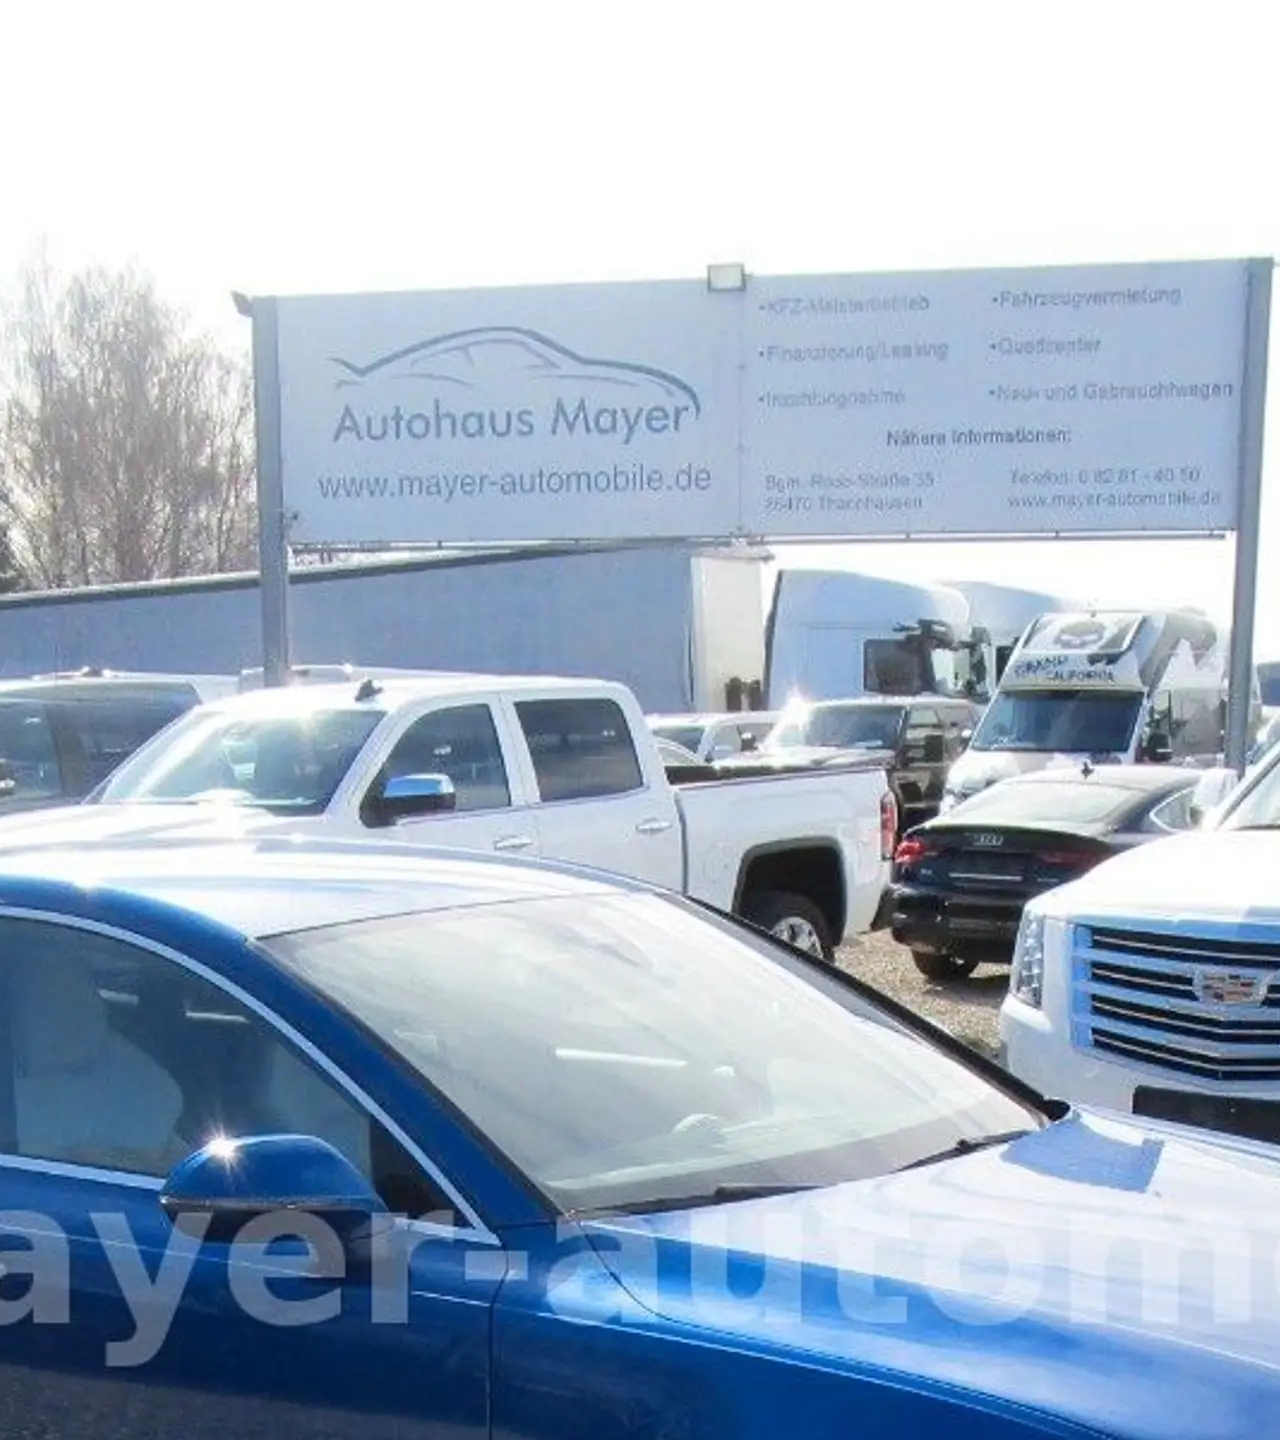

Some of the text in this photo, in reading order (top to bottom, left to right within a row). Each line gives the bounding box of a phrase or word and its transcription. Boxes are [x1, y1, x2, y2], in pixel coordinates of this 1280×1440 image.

[1045, 383, 1077, 400] und
[333, 396, 687, 446] Autohaus Mayer
[317, 463, 712, 504] www.mayer-automobile.de
